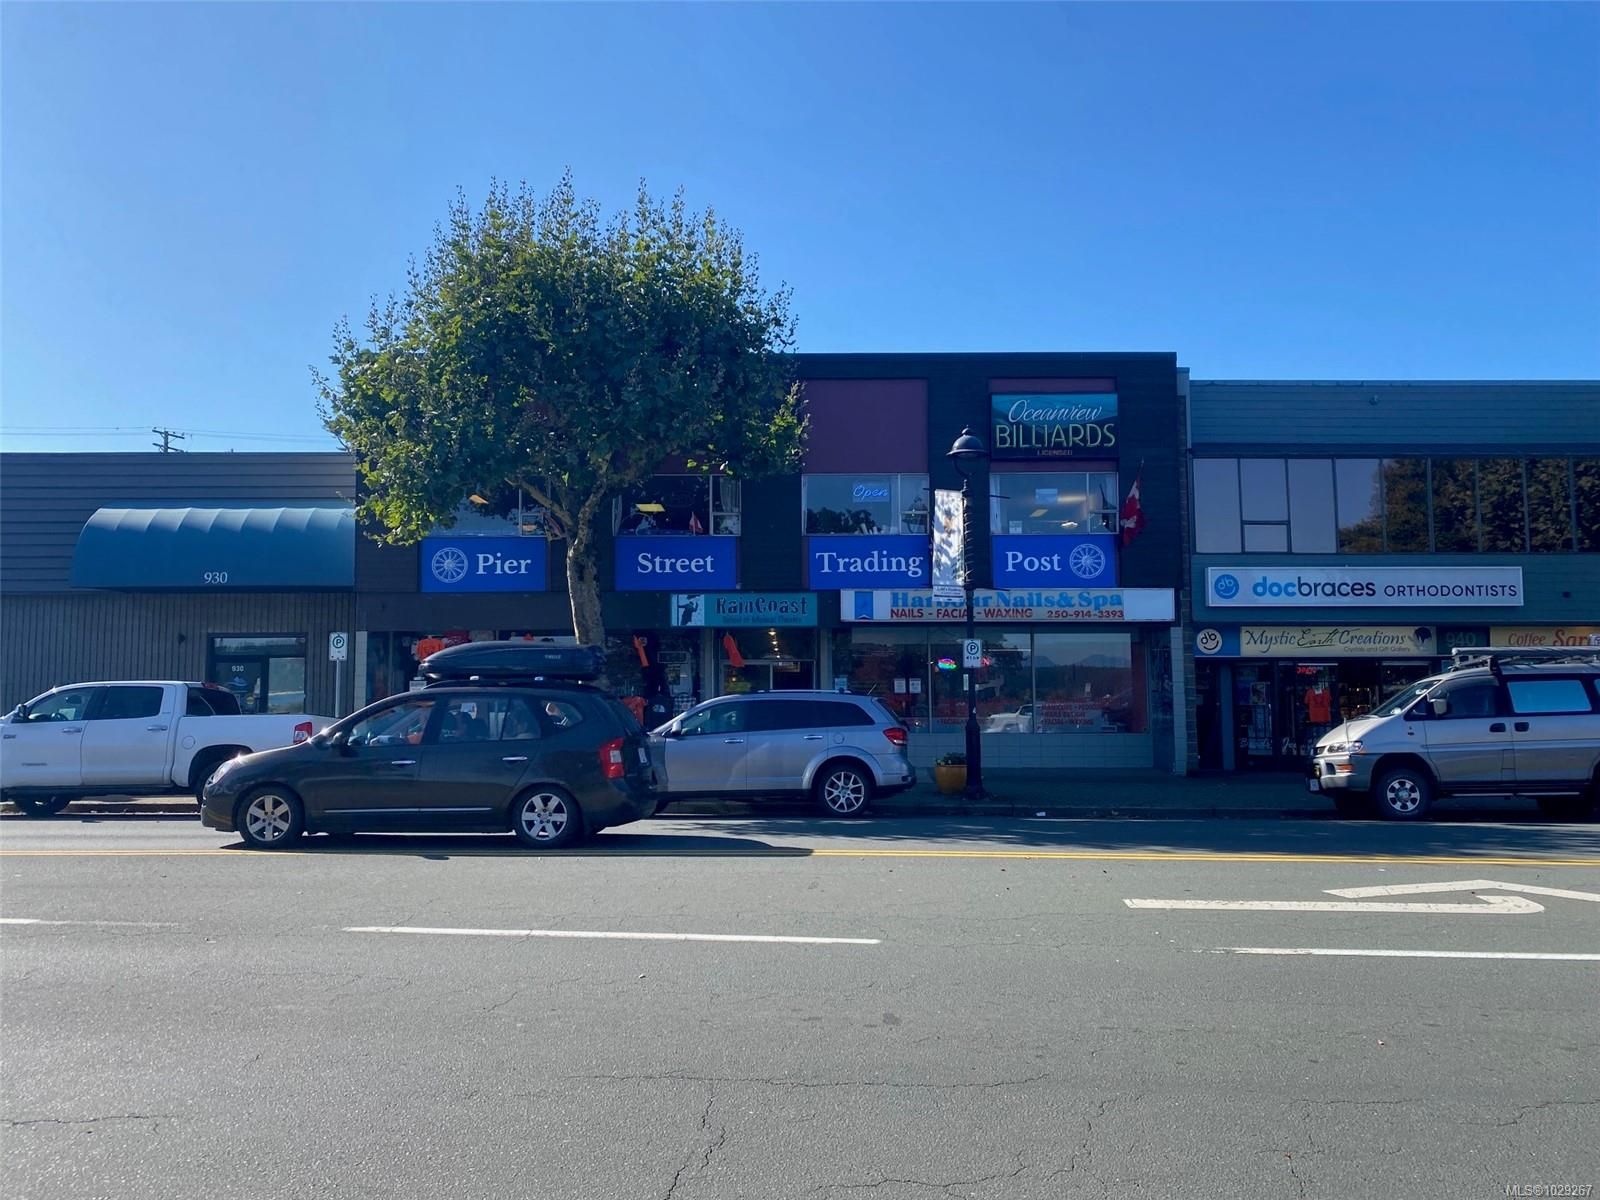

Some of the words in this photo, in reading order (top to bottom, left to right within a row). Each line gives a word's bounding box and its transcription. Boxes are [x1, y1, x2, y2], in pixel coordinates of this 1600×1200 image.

[1008, 399, 1102, 423] Oceanview
[996, 424, 1116, 448] BILLIARDS
[853, 485, 888, 502] Open
[476, 552, 531, 575] Pier
[637, 552, 715, 574] Street
[816, 551, 924, 577] Trading
[1005, 551, 1062, 572] Post
[204, 571, 228, 585] 930
[1252, 576, 1376, 597] docbraces
[1384, 585, 1518, 597] ORTHODONTISTS
[716, 597, 808, 615] RainCoast
[891, 608, 924, 618] NAILS
[936, 608, 975, 618] FACIA
[983, 608, 1033, 618] WAXING
[1047, 610, 1124, 618] 250-914-3393
[1244, 629, 1296, 654] Mystic
[1338, 628, 1407, 647] Creations
[1446, 632, 1476, 648] 940
[1508, 632, 1546, 647] Coffee
